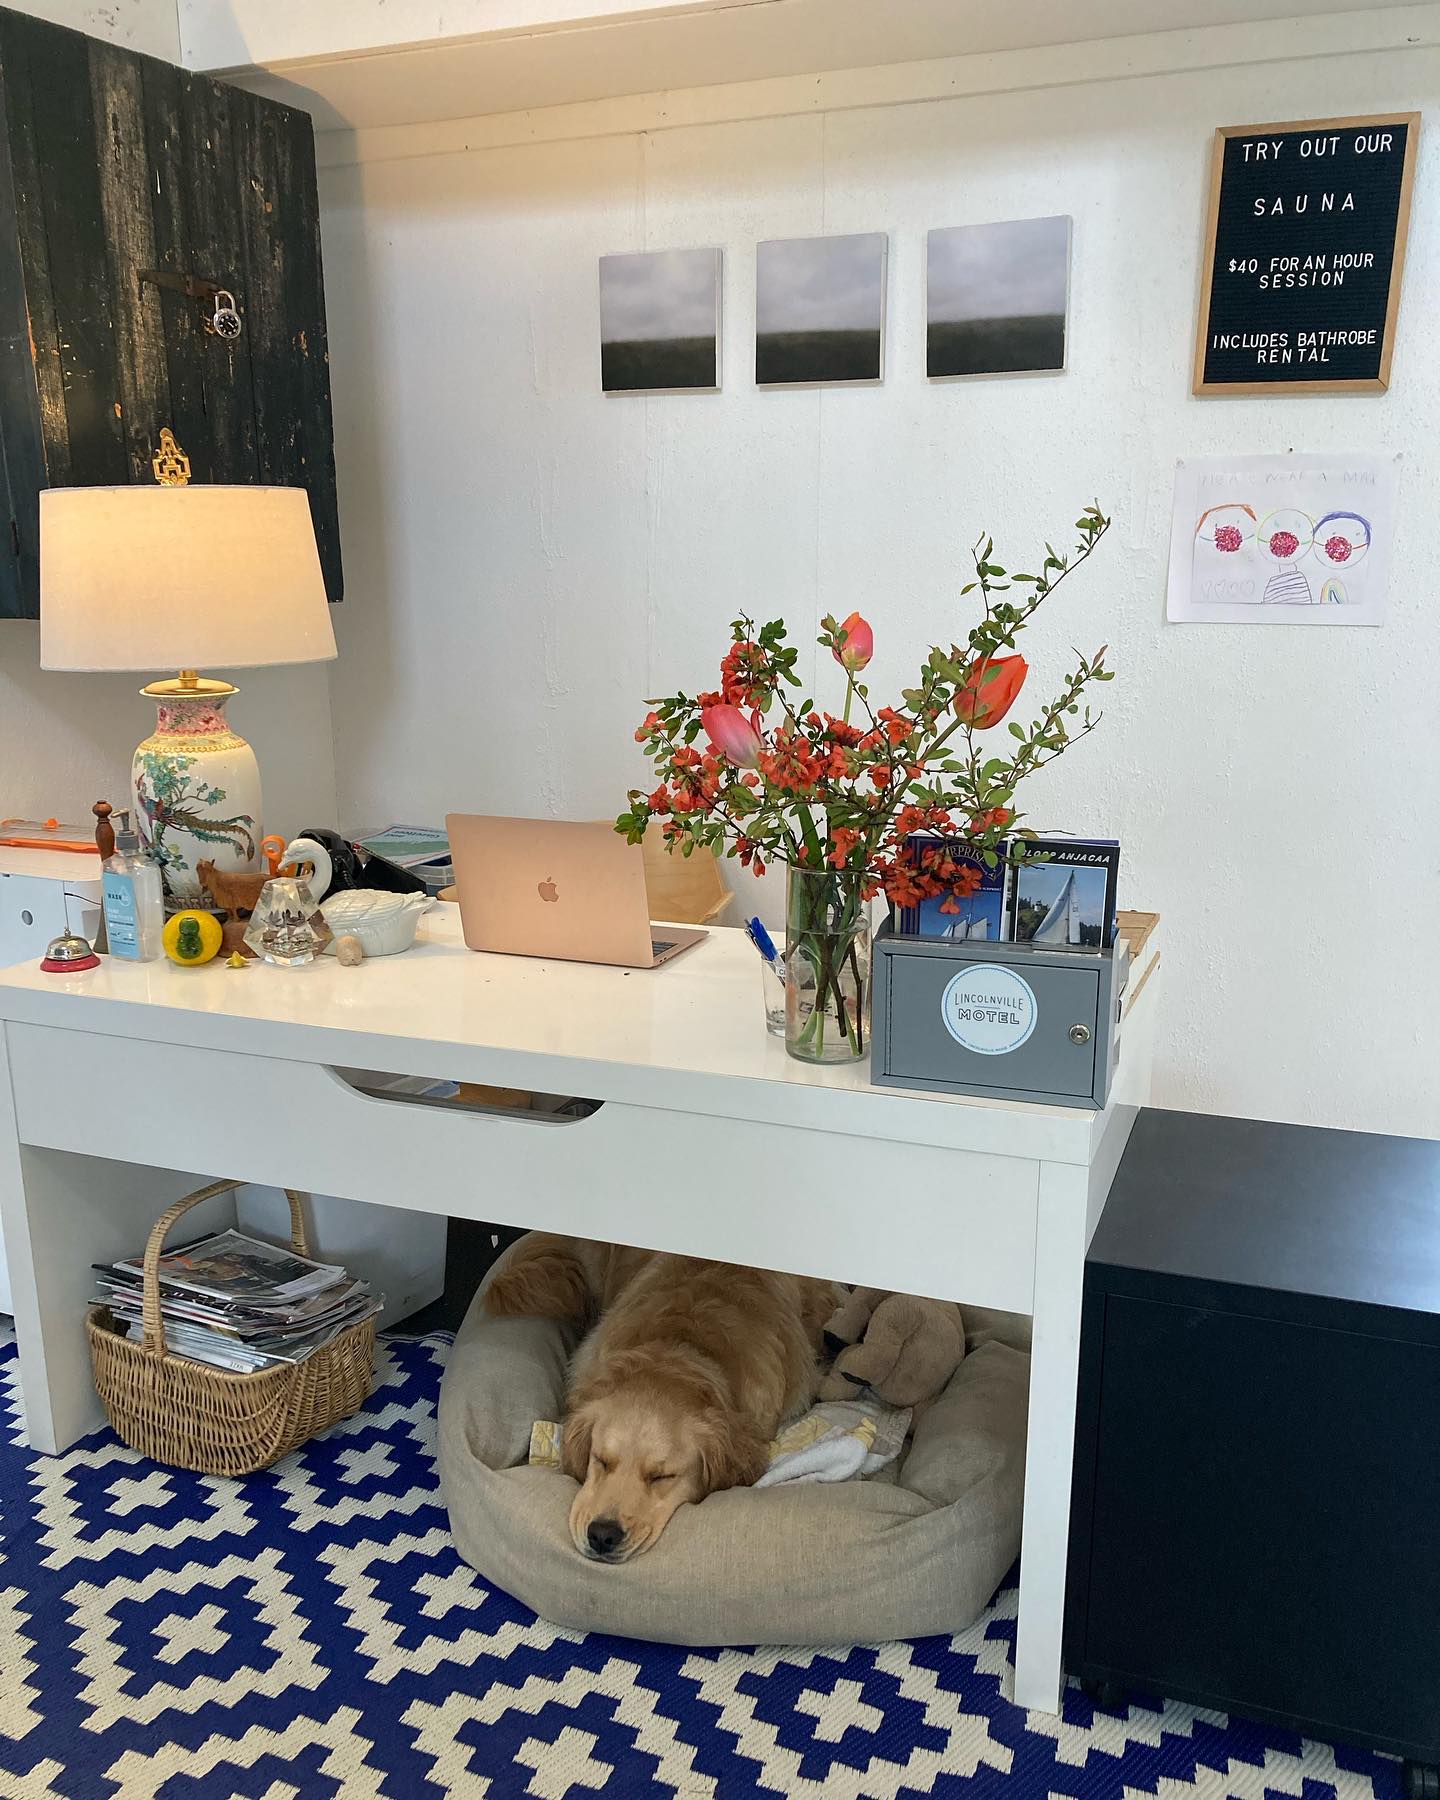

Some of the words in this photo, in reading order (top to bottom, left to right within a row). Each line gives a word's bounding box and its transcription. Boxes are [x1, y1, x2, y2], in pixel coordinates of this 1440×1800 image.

[1243, 141, 1283, 162] TRY
[1300, 137, 1340, 157] OUT
[1355, 134, 1392, 153] OUR
[1254, 193, 1353, 215] SAUNA
[1229, 259, 1257, 273] $40
[1271, 257, 1299, 272] FOR
[1303, 255, 1325, 269] AN
[1333, 253, 1373, 268] HOUR
[1260, 270, 1344, 289] SESSION
[1214, 333, 1288, 348] INCLUDES
[1298, 330, 1376, 346] BATHROBE
[1258, 348, 1329, 363] RENTAL
[1057, 852, 1111, 863] ANJACAA
[954, 993, 1024, 1012] LINCOLNVILLE
[958, 1008, 1021, 1025] MOTEL
